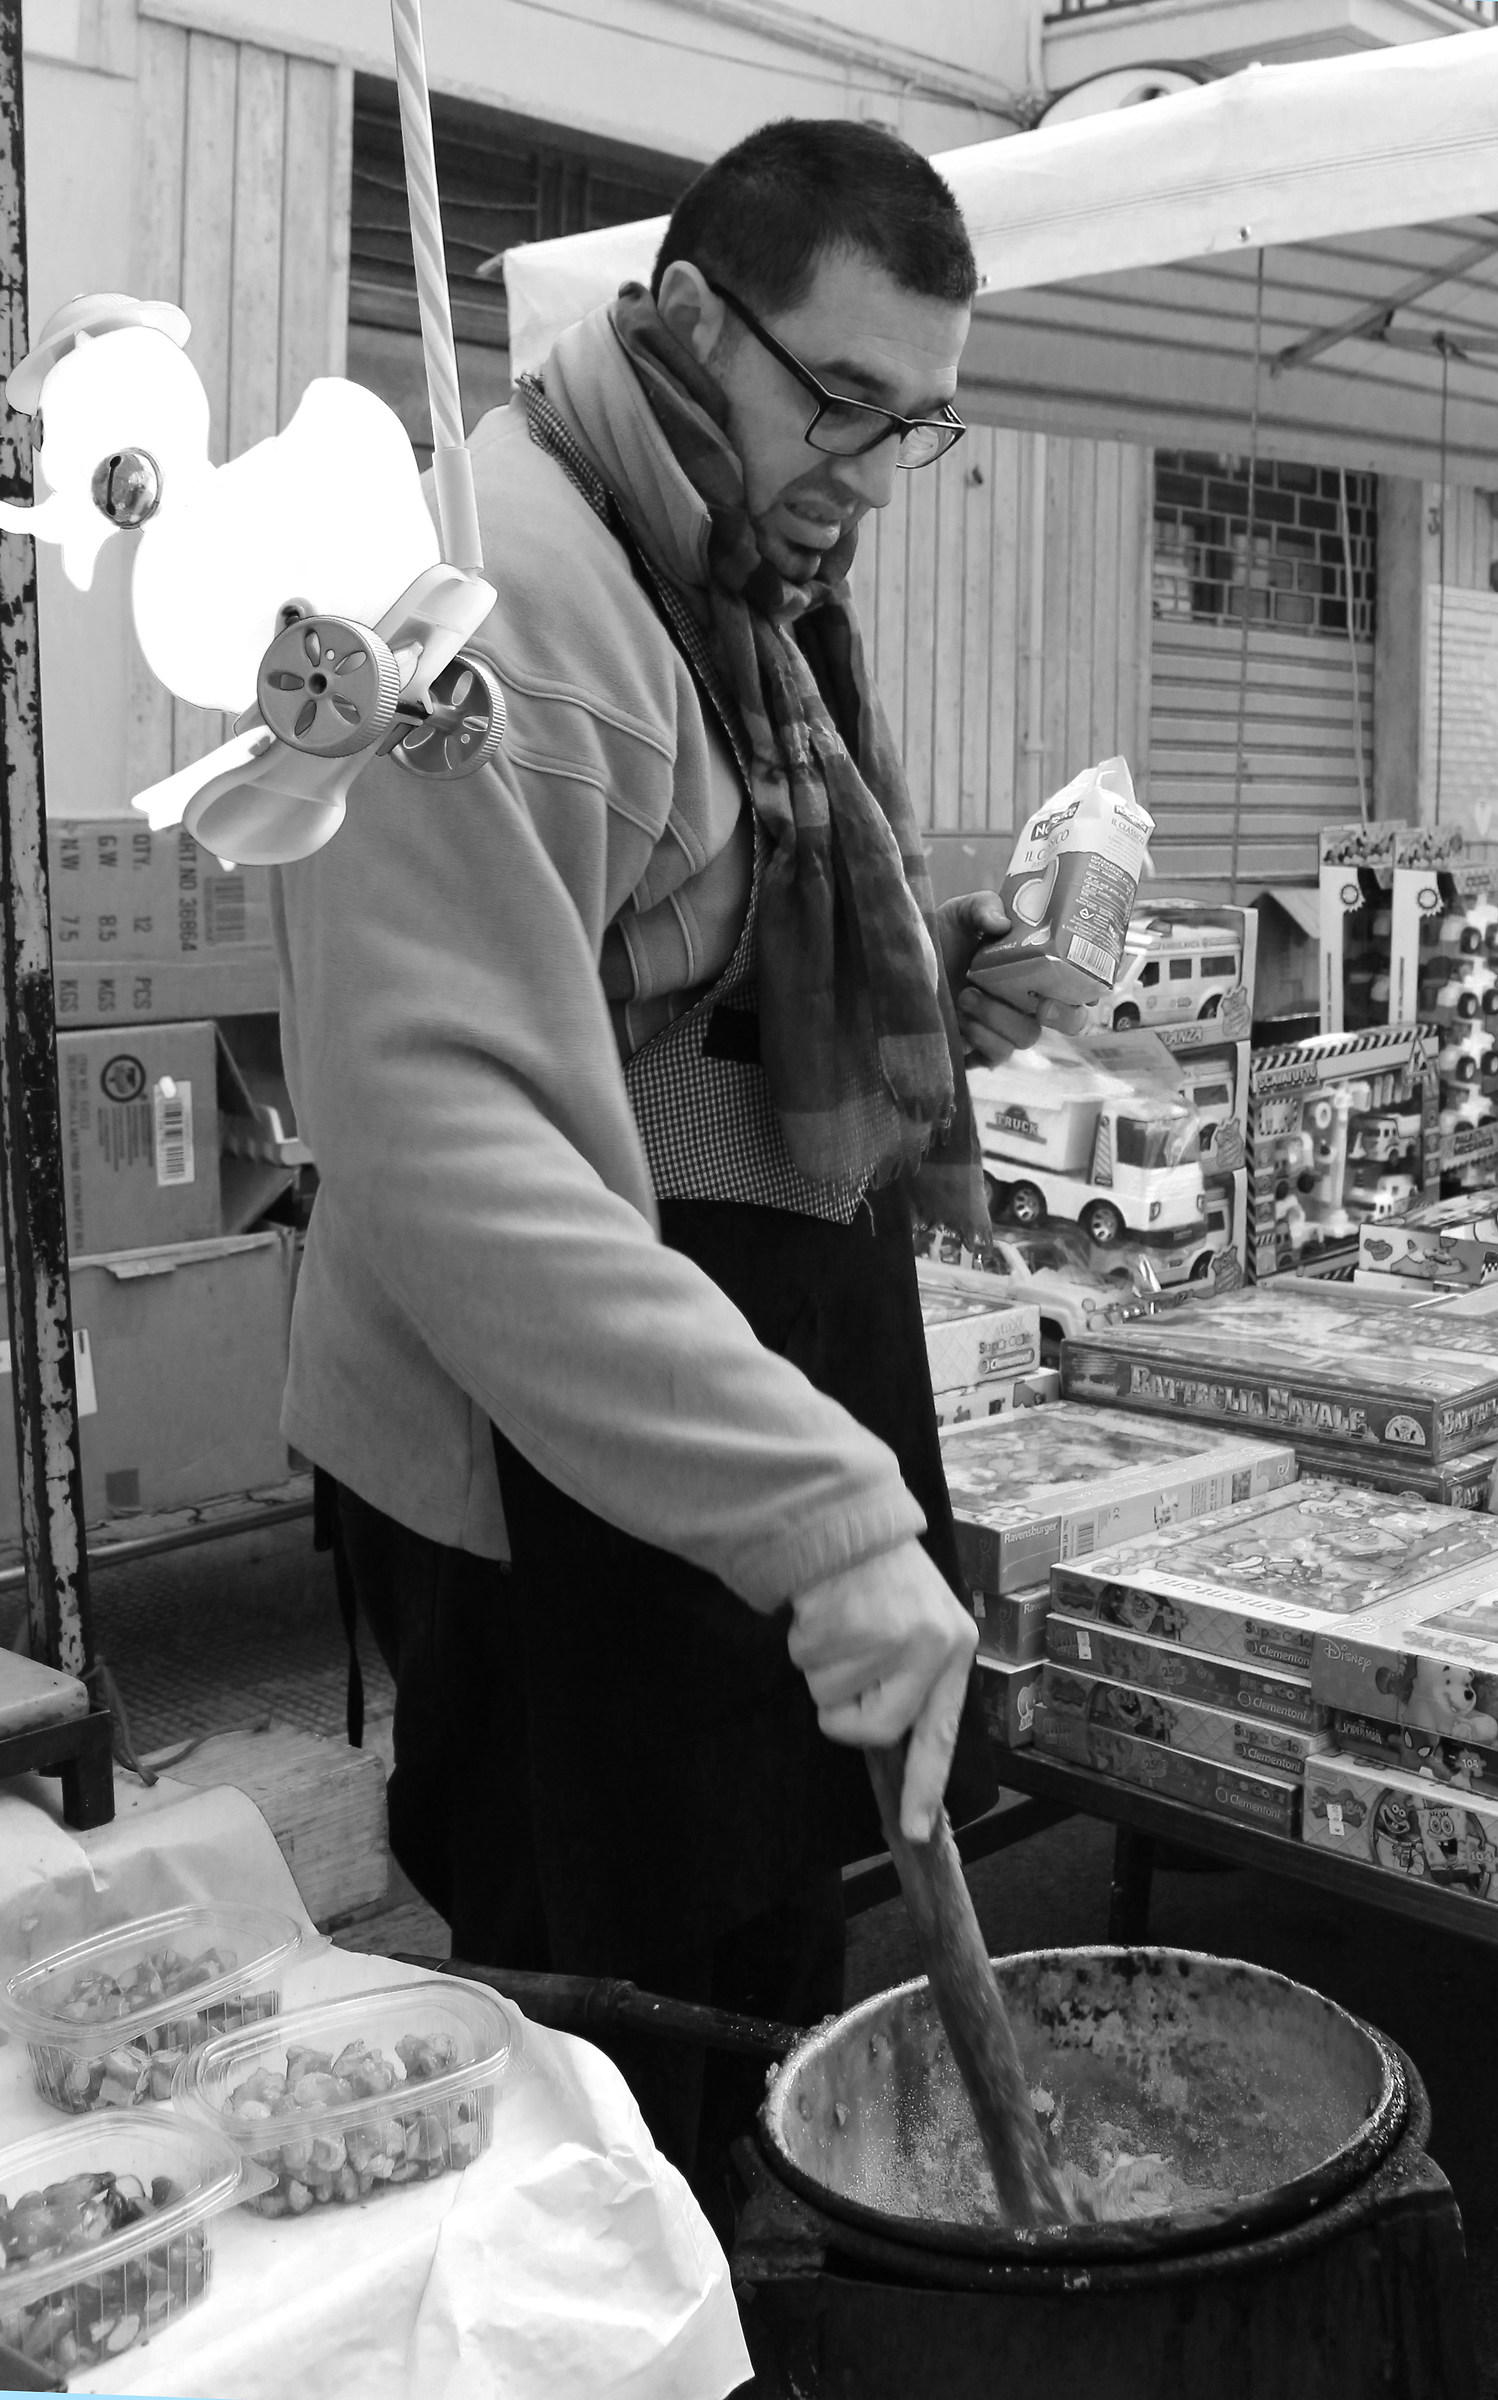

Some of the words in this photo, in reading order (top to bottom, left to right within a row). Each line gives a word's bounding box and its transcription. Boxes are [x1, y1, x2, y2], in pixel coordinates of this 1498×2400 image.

[133, 916, 152, 933] 12
[179, 898, 198, 952] 36864
[59, 979, 79, 1013] KGS
[98, 978, 116, 1012] KGS
[133, 976, 152, 1010] PCS
[995, 1112, 1039, 1136] TRUCK
[1004, 1523, 1059, 1545] Ravensburger
[1259, 1644, 1311, 1666] Clementon
[1253, 1697, 1307, 1721] Clementoni
[1248, 1748, 1301, 1773] Clementoni
[1462, 1758, 1479, 1769] 104
[1229, 1793, 1281, 1820] Clementoni
